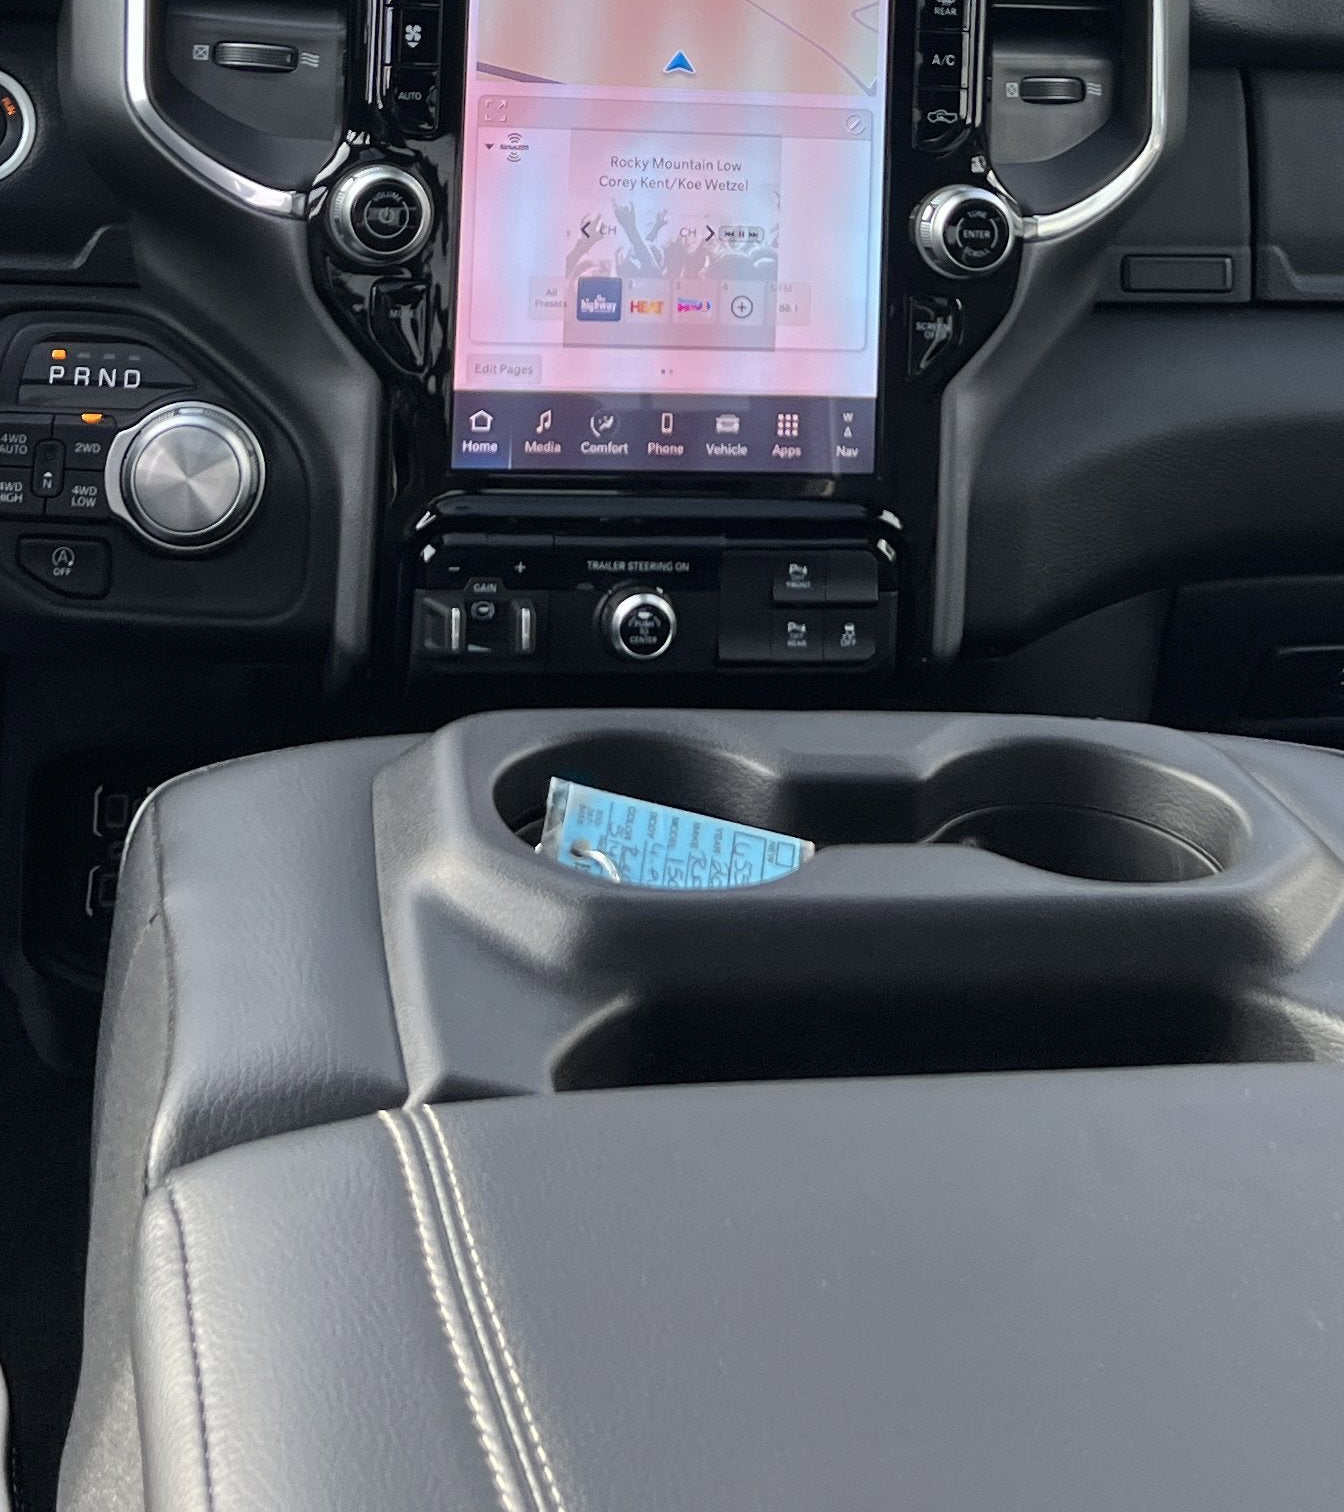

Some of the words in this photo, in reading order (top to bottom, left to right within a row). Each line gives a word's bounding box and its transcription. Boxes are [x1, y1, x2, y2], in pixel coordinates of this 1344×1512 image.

[934, 7, 957, 16] REAR
[931, 54, 955, 66] A/C
[398, 91, 423, 101] AUTO
[610, 155, 649, 171] Rocky
[652, 157, 714, 171] Mountain
[717, 159, 742, 172] Low
[599, 175, 637, 190] Corey
[640, 177, 702, 191] Kent/Koe
[705, 179, 749, 192] Wetzel
[600, 224, 617, 236] CH
[679, 227, 696, 238] CH
[962, 230, 991, 239] ENTER
[545, 288, 558, 297] All
[535, 299, 568, 308] Presets
[581, 299, 618, 314] highway
[630, 300, 664, 314] HEAT
[475, 362, 497, 374] Edit
[499, 364, 533, 376] Pages
[49, 366, 65, 385] P
[74, 367, 90, 386] R
[98, 368, 117, 387] N
[124, 369, 141, 388] D
[1, 434, 27, 444] 4WD
[74, 442, 101, 454] 2WD
[462, 440, 499, 453] Home
[524, 441, 561, 453] Media
[580, 441, 629, 454] Comfort
[647, 442, 684, 455] Phone
[706, 443, 748, 456] Vehicle
[771, 444, 802, 458] Apps
[836, 445, 859, 457] Nav
[42, 478, 52, 489] N
[72, 486, 97, 497] 4WD
[71, 496, 96, 507] LOW
[52, 566, 71, 576] OFF
[587, 560, 625, 571] TRAILER
[627, 561, 673, 572] STEERING
[675, 561, 690, 572] ON
[473, 582, 497, 593] GAIN
[630, 635, 658, 644] CENTER
[624, 805, 636, 841] COLOR
[647, 810, 658, 840] BODY
[667, 816, 679, 849] MODEL
[714, 827, 723, 854] YEAR
[766, 840, 776, 864] NEW
